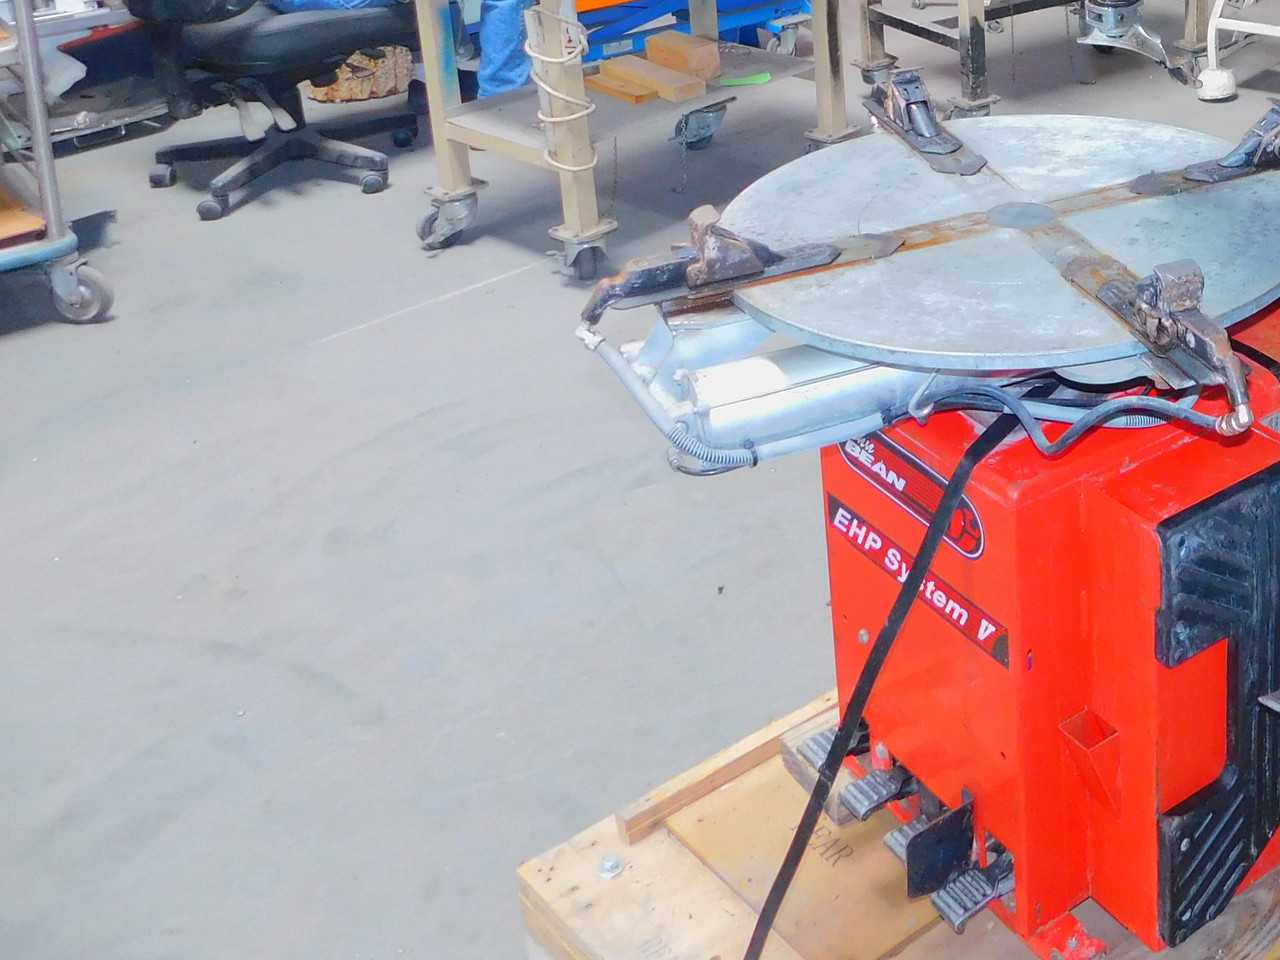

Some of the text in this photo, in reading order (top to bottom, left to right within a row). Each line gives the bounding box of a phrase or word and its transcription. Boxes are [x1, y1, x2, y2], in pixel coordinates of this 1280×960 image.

[844, 439, 907, 492] BEAN
[832, 506, 882, 551] EHP
[884, 547, 969, 626] Sytem
[805, 824, 855, 868] EAR
